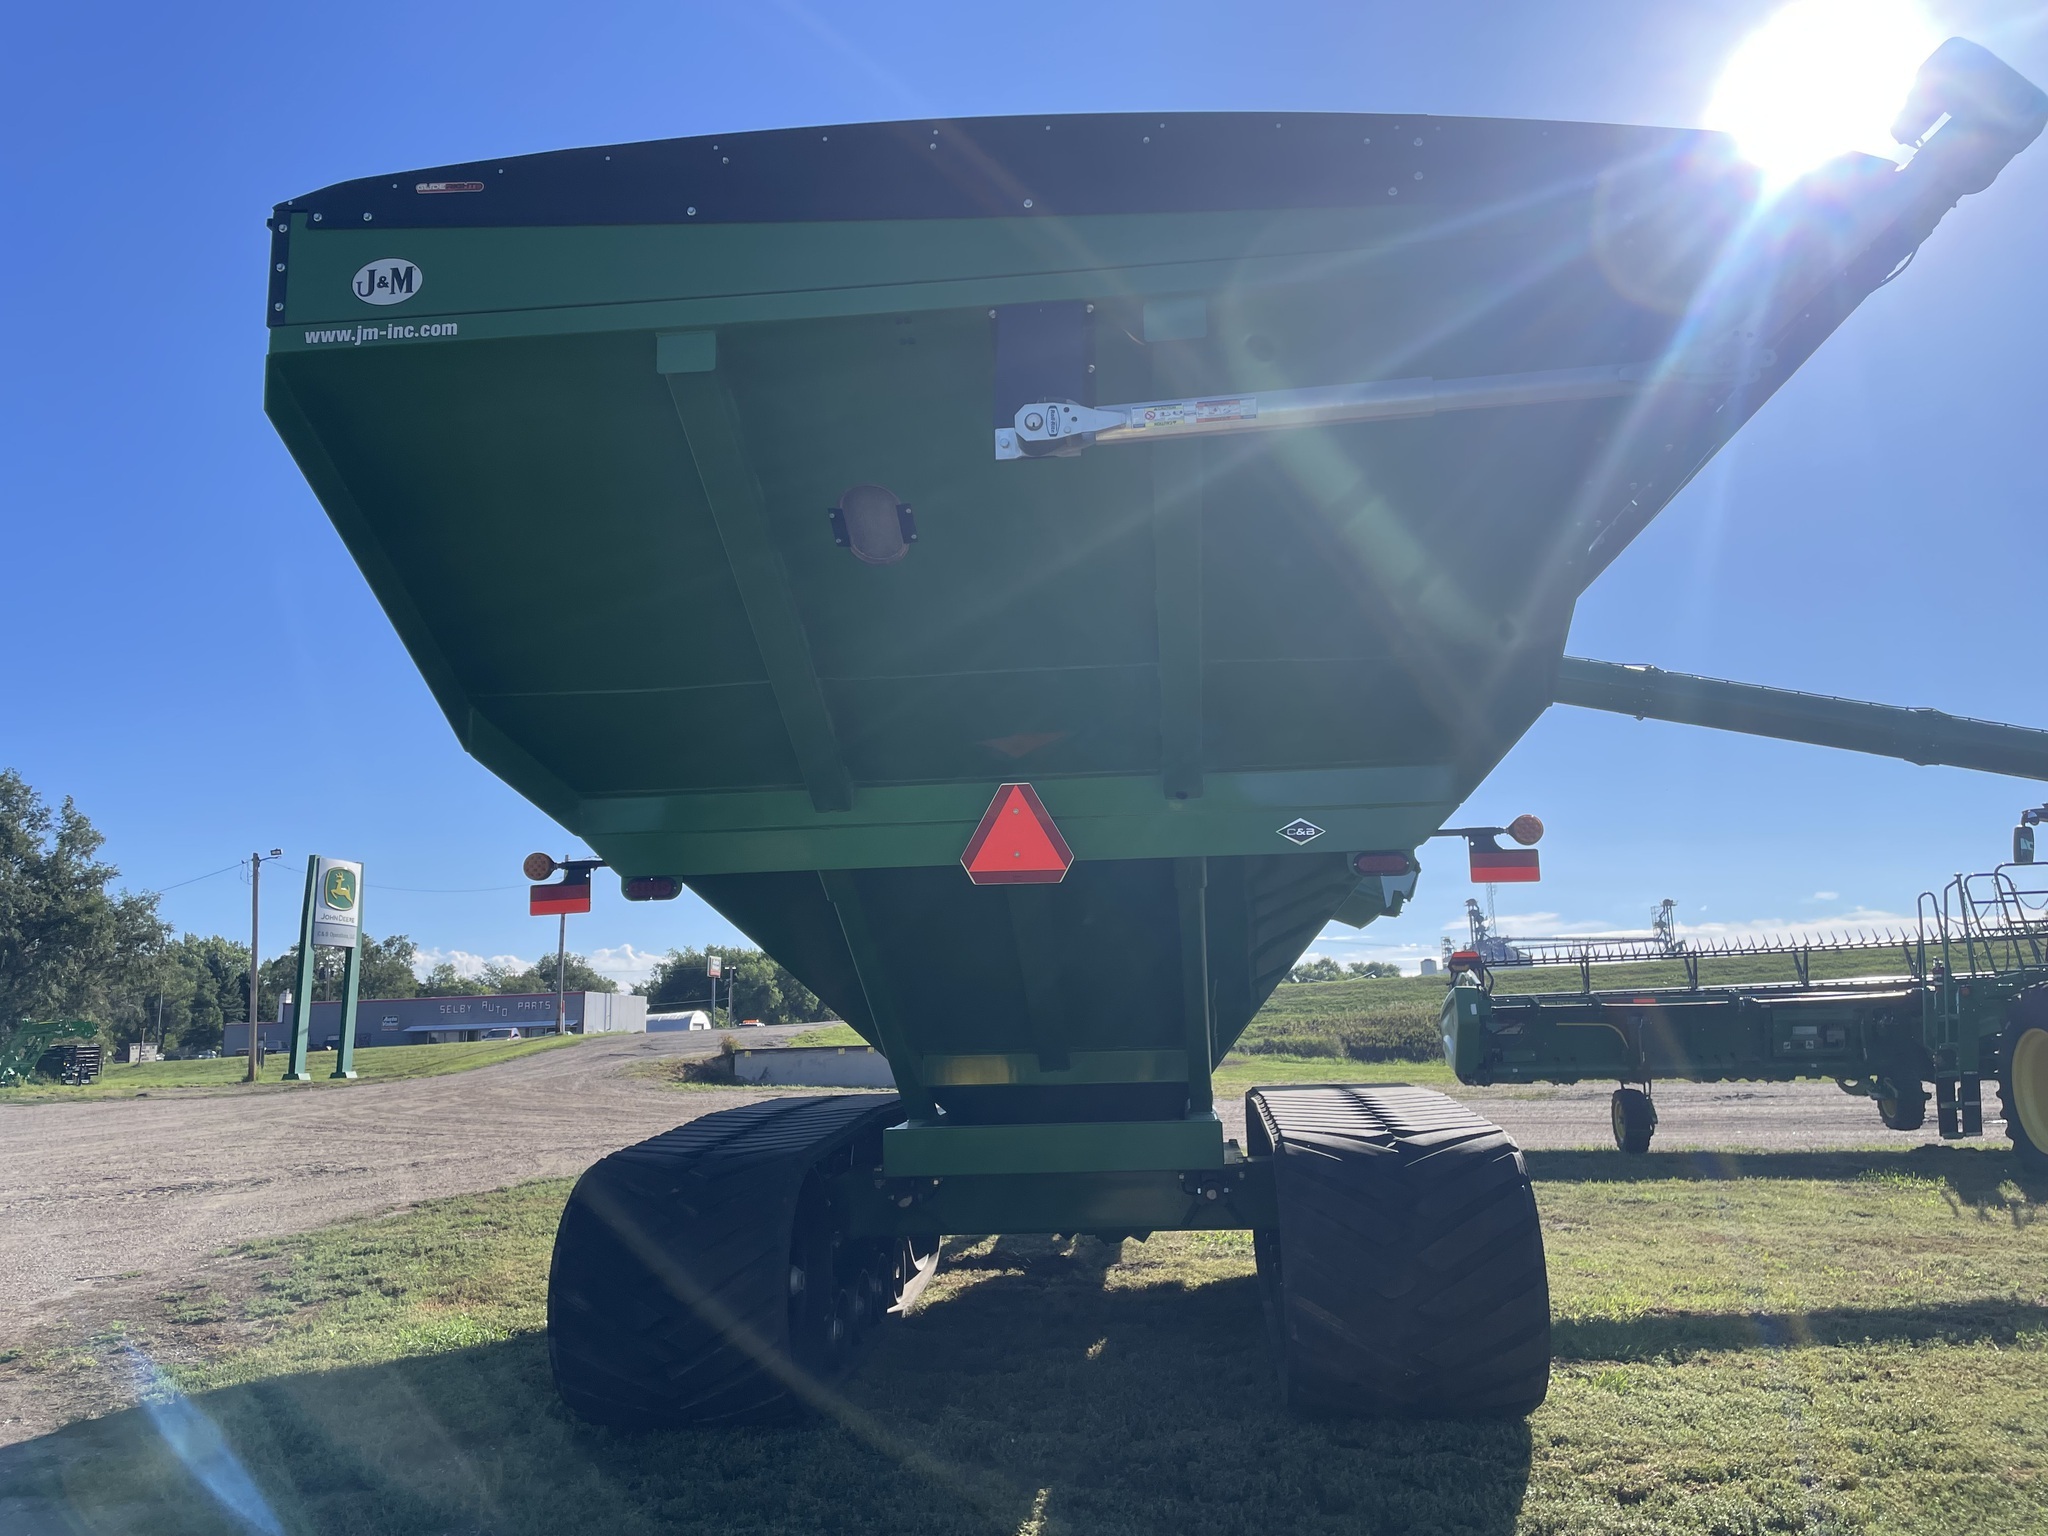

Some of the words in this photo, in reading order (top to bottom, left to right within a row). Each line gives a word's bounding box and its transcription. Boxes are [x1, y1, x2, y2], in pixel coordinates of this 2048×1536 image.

[356, 266, 415, 297] J&M
[305, 322, 458, 346] www.jm-inc.com
[1286, 828, 1315, 836] C&B
[321, 913, 338, 921] JOHN
[339, 915, 355, 923] DEERE
[439, 1004, 472, 1014] SELBY
[482, 1001, 508, 1016] AUTO
[518, 1001, 551, 1010] PARTS
